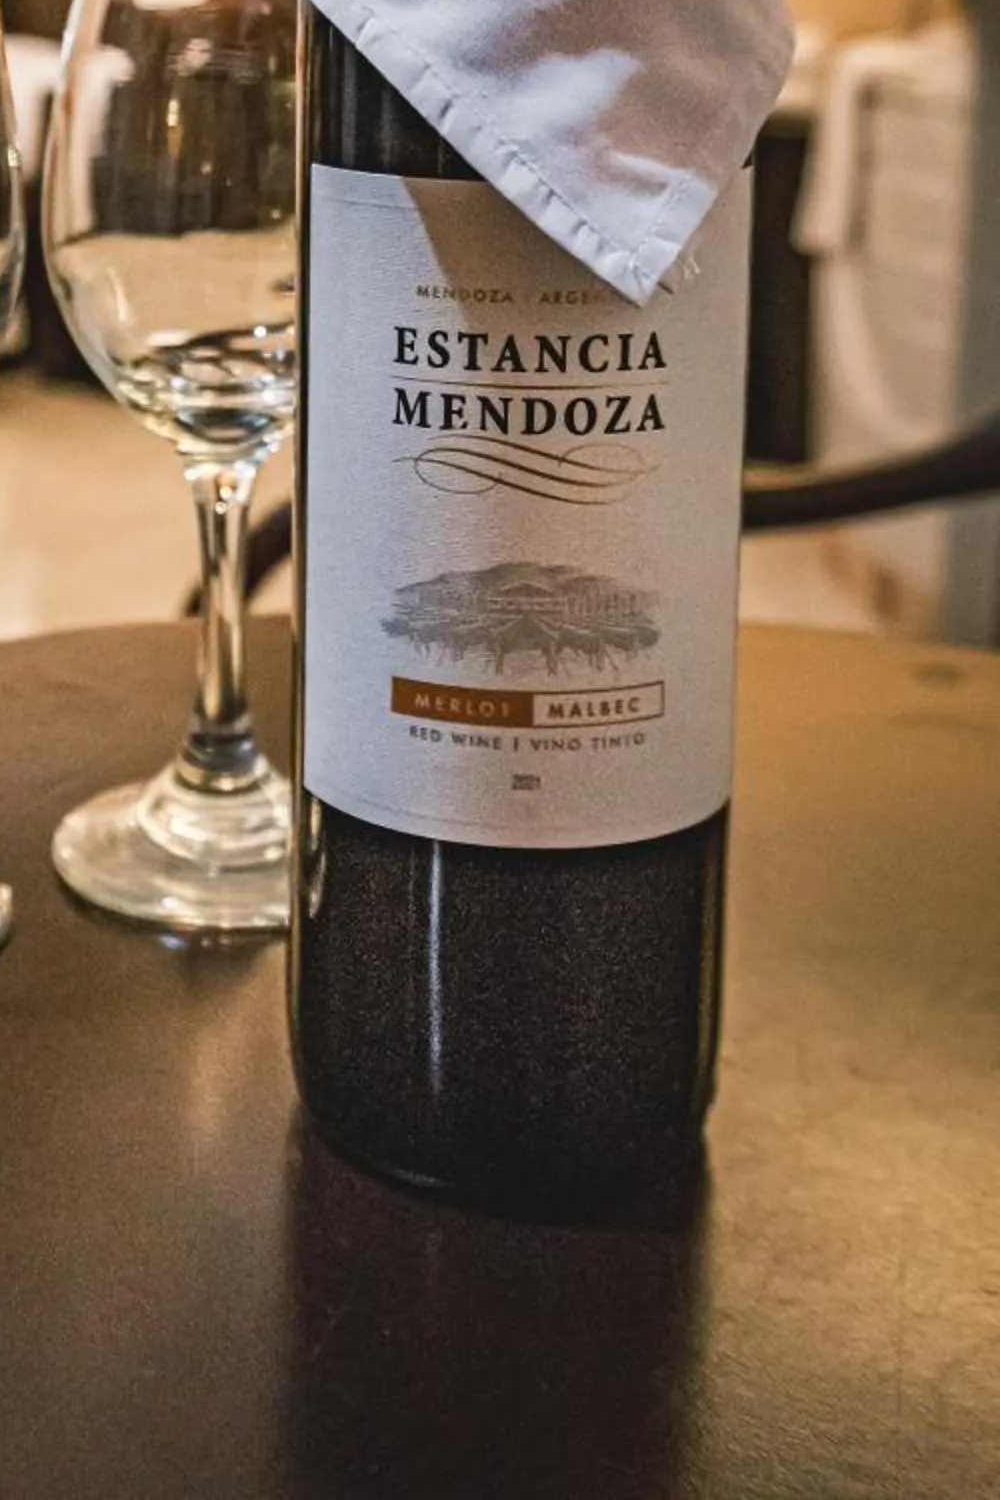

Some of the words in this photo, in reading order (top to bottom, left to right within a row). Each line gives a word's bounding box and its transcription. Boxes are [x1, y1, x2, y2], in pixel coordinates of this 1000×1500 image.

[416, 285, 514, 304] MENDOZA
[393, 326, 667, 373] ESTANCIA
[392, 388, 666, 435] MENDOZA
[414, 693, 509, 717] MERLOT
[546, 696, 642, 720] MALBEC
[409, 725, 442, 742] RED
[450, 733, 501, 751] WINE
[529, 738, 582, 752] VINO
[590, 731, 646, 749] TINTO
